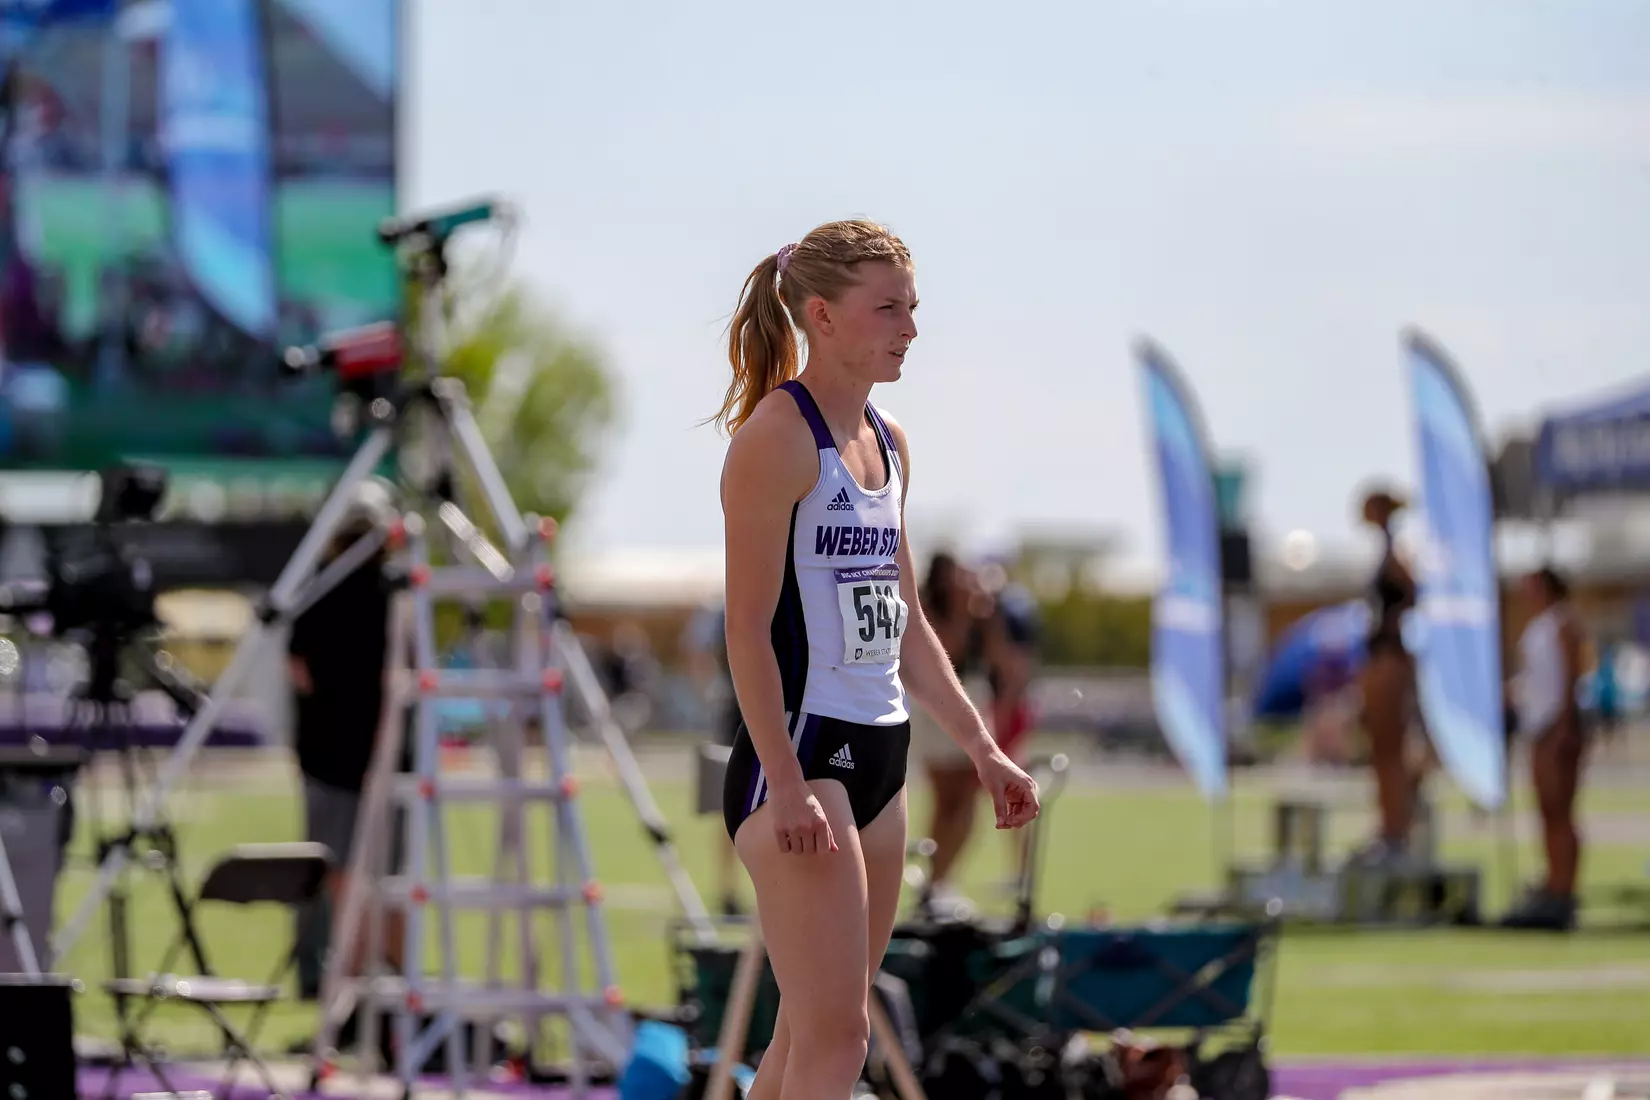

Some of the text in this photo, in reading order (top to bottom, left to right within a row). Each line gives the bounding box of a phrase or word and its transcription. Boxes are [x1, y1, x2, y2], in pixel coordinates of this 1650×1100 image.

[827, 502, 854, 511] adidas
[815, 526, 878, 556] WEBER
[829, 757, 855, 769] adidas
